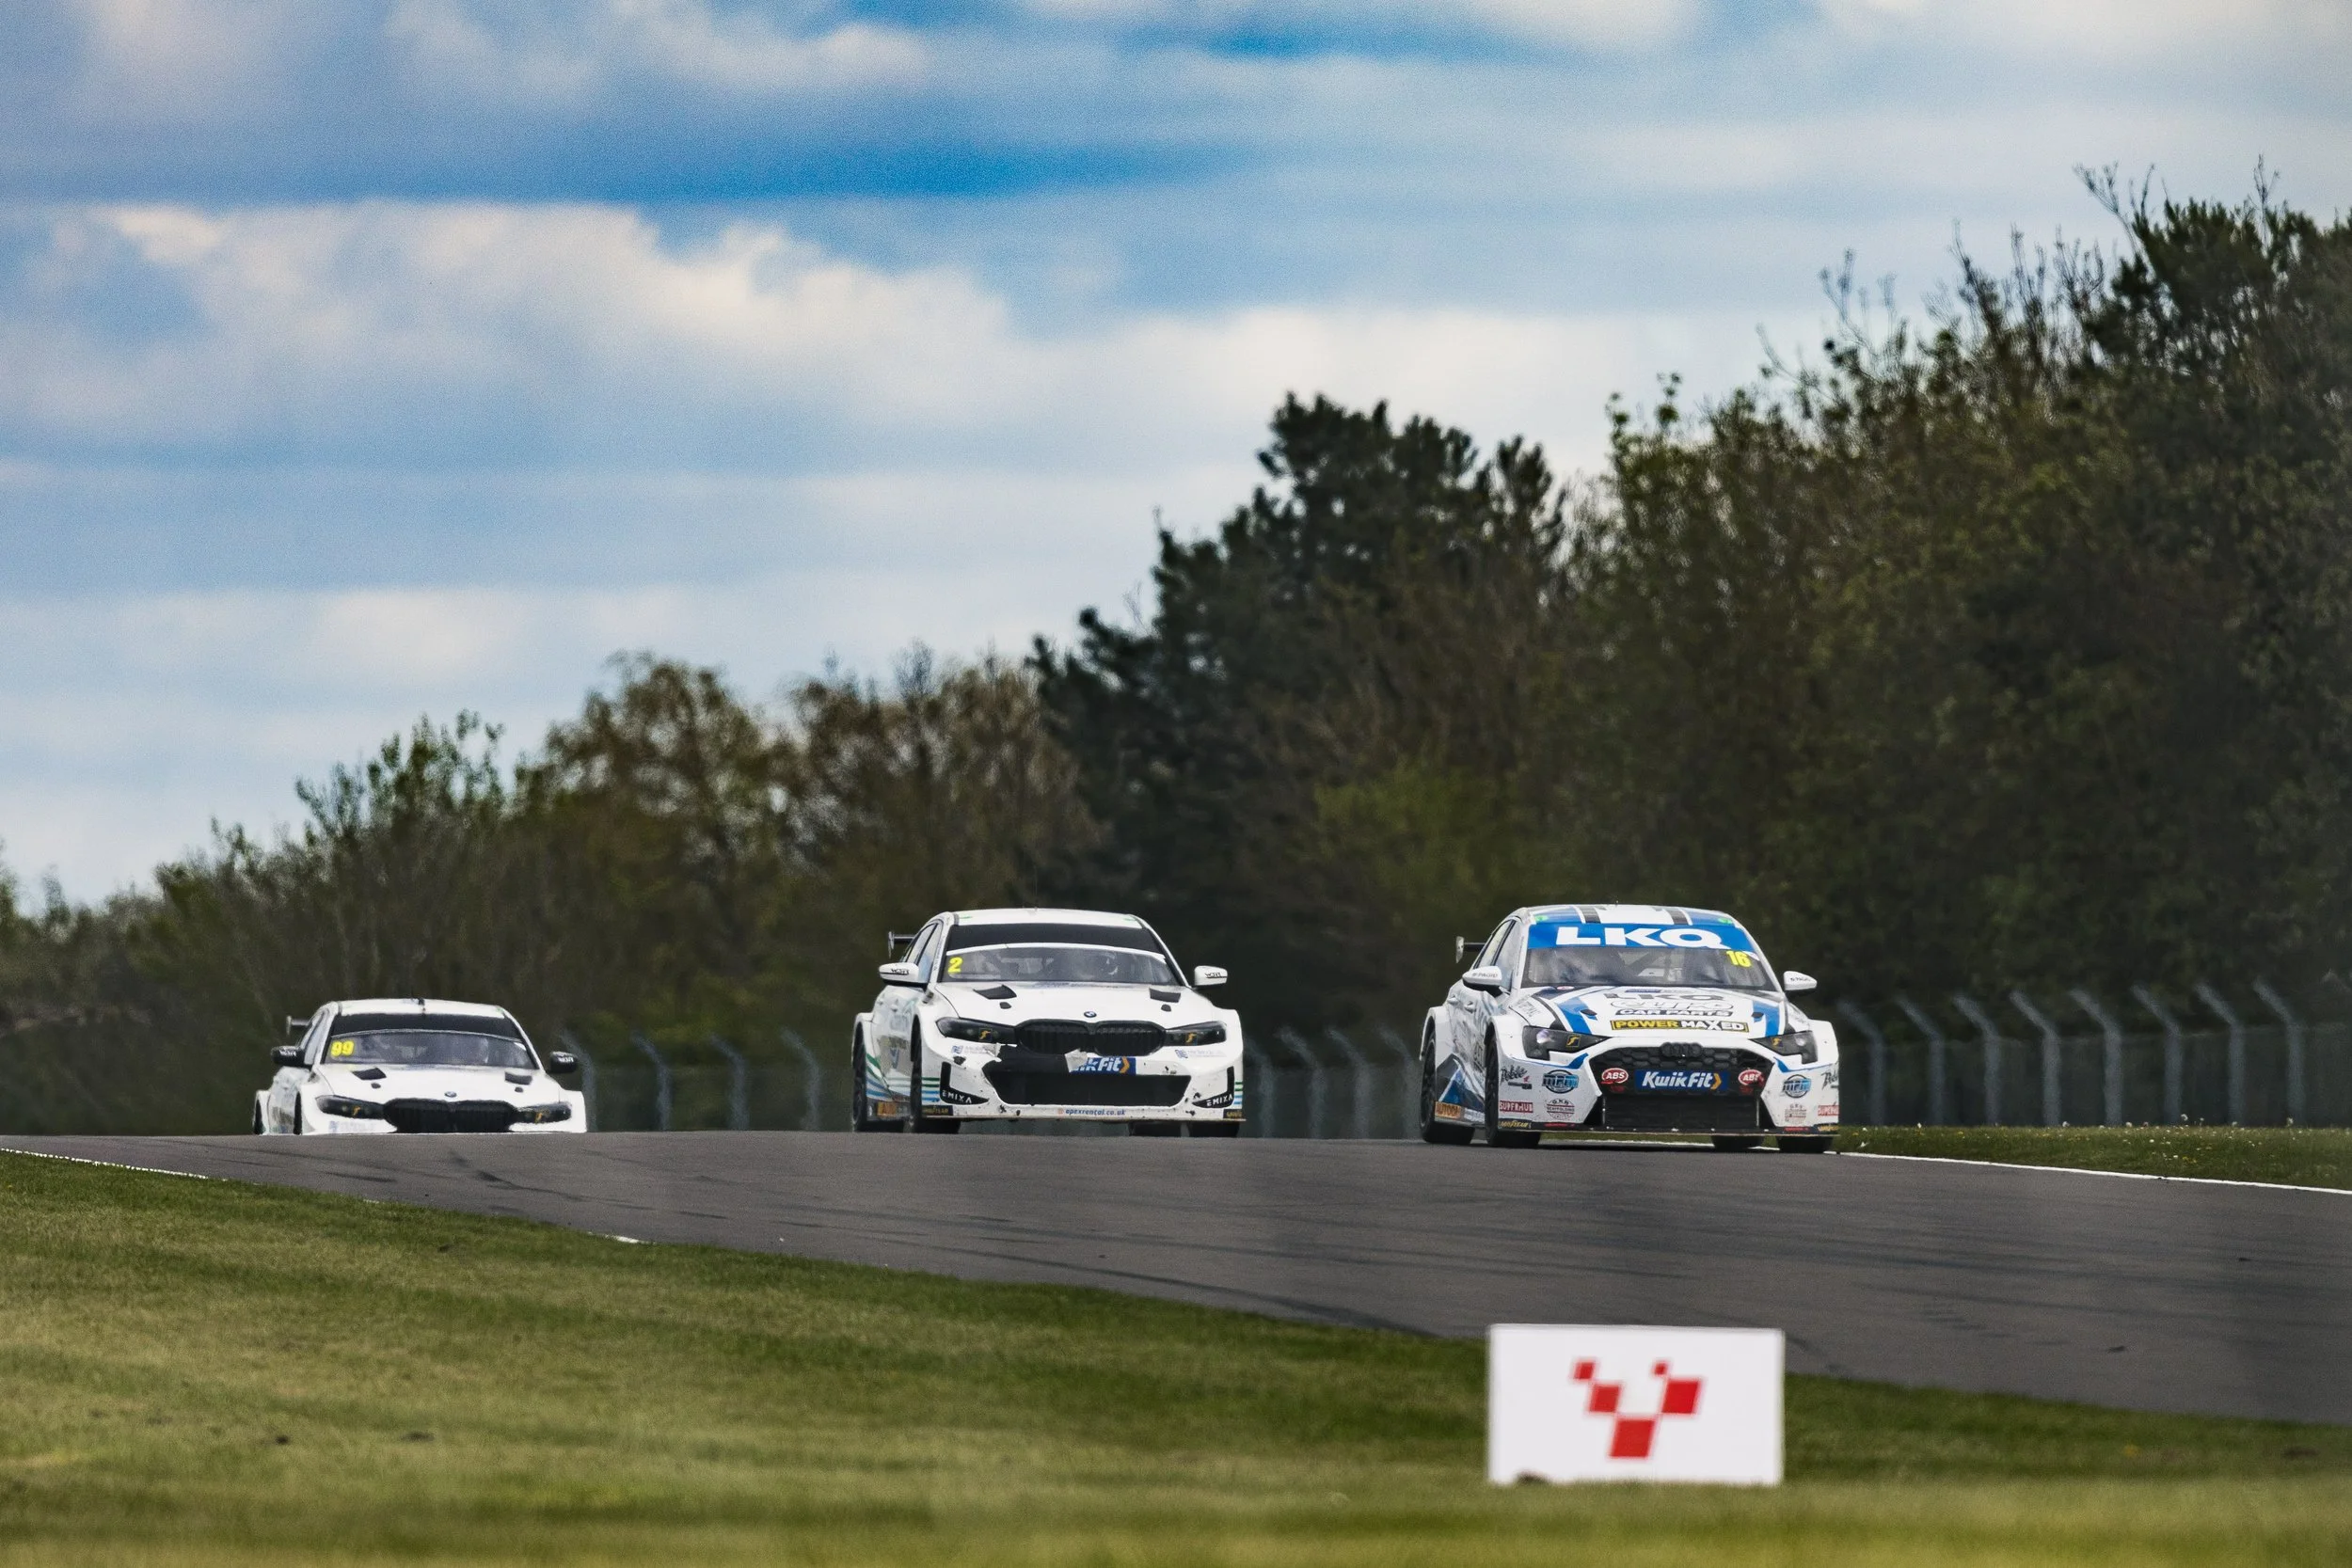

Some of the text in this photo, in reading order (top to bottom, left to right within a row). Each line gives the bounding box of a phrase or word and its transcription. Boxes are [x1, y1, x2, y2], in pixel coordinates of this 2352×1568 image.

[1555, 927, 1732, 950] LKQ
[947, 957, 963, 973] 2
[1725, 950, 1752, 967] 16
[1614, 1019, 1679, 1029] POWER
[330, 1040, 355, 1057] 99
[1605, 1070, 1626, 1080] ABS
[942, 1089, 973, 1104] EMIXA
[1205, 1093, 1233, 1107] EMIXA
